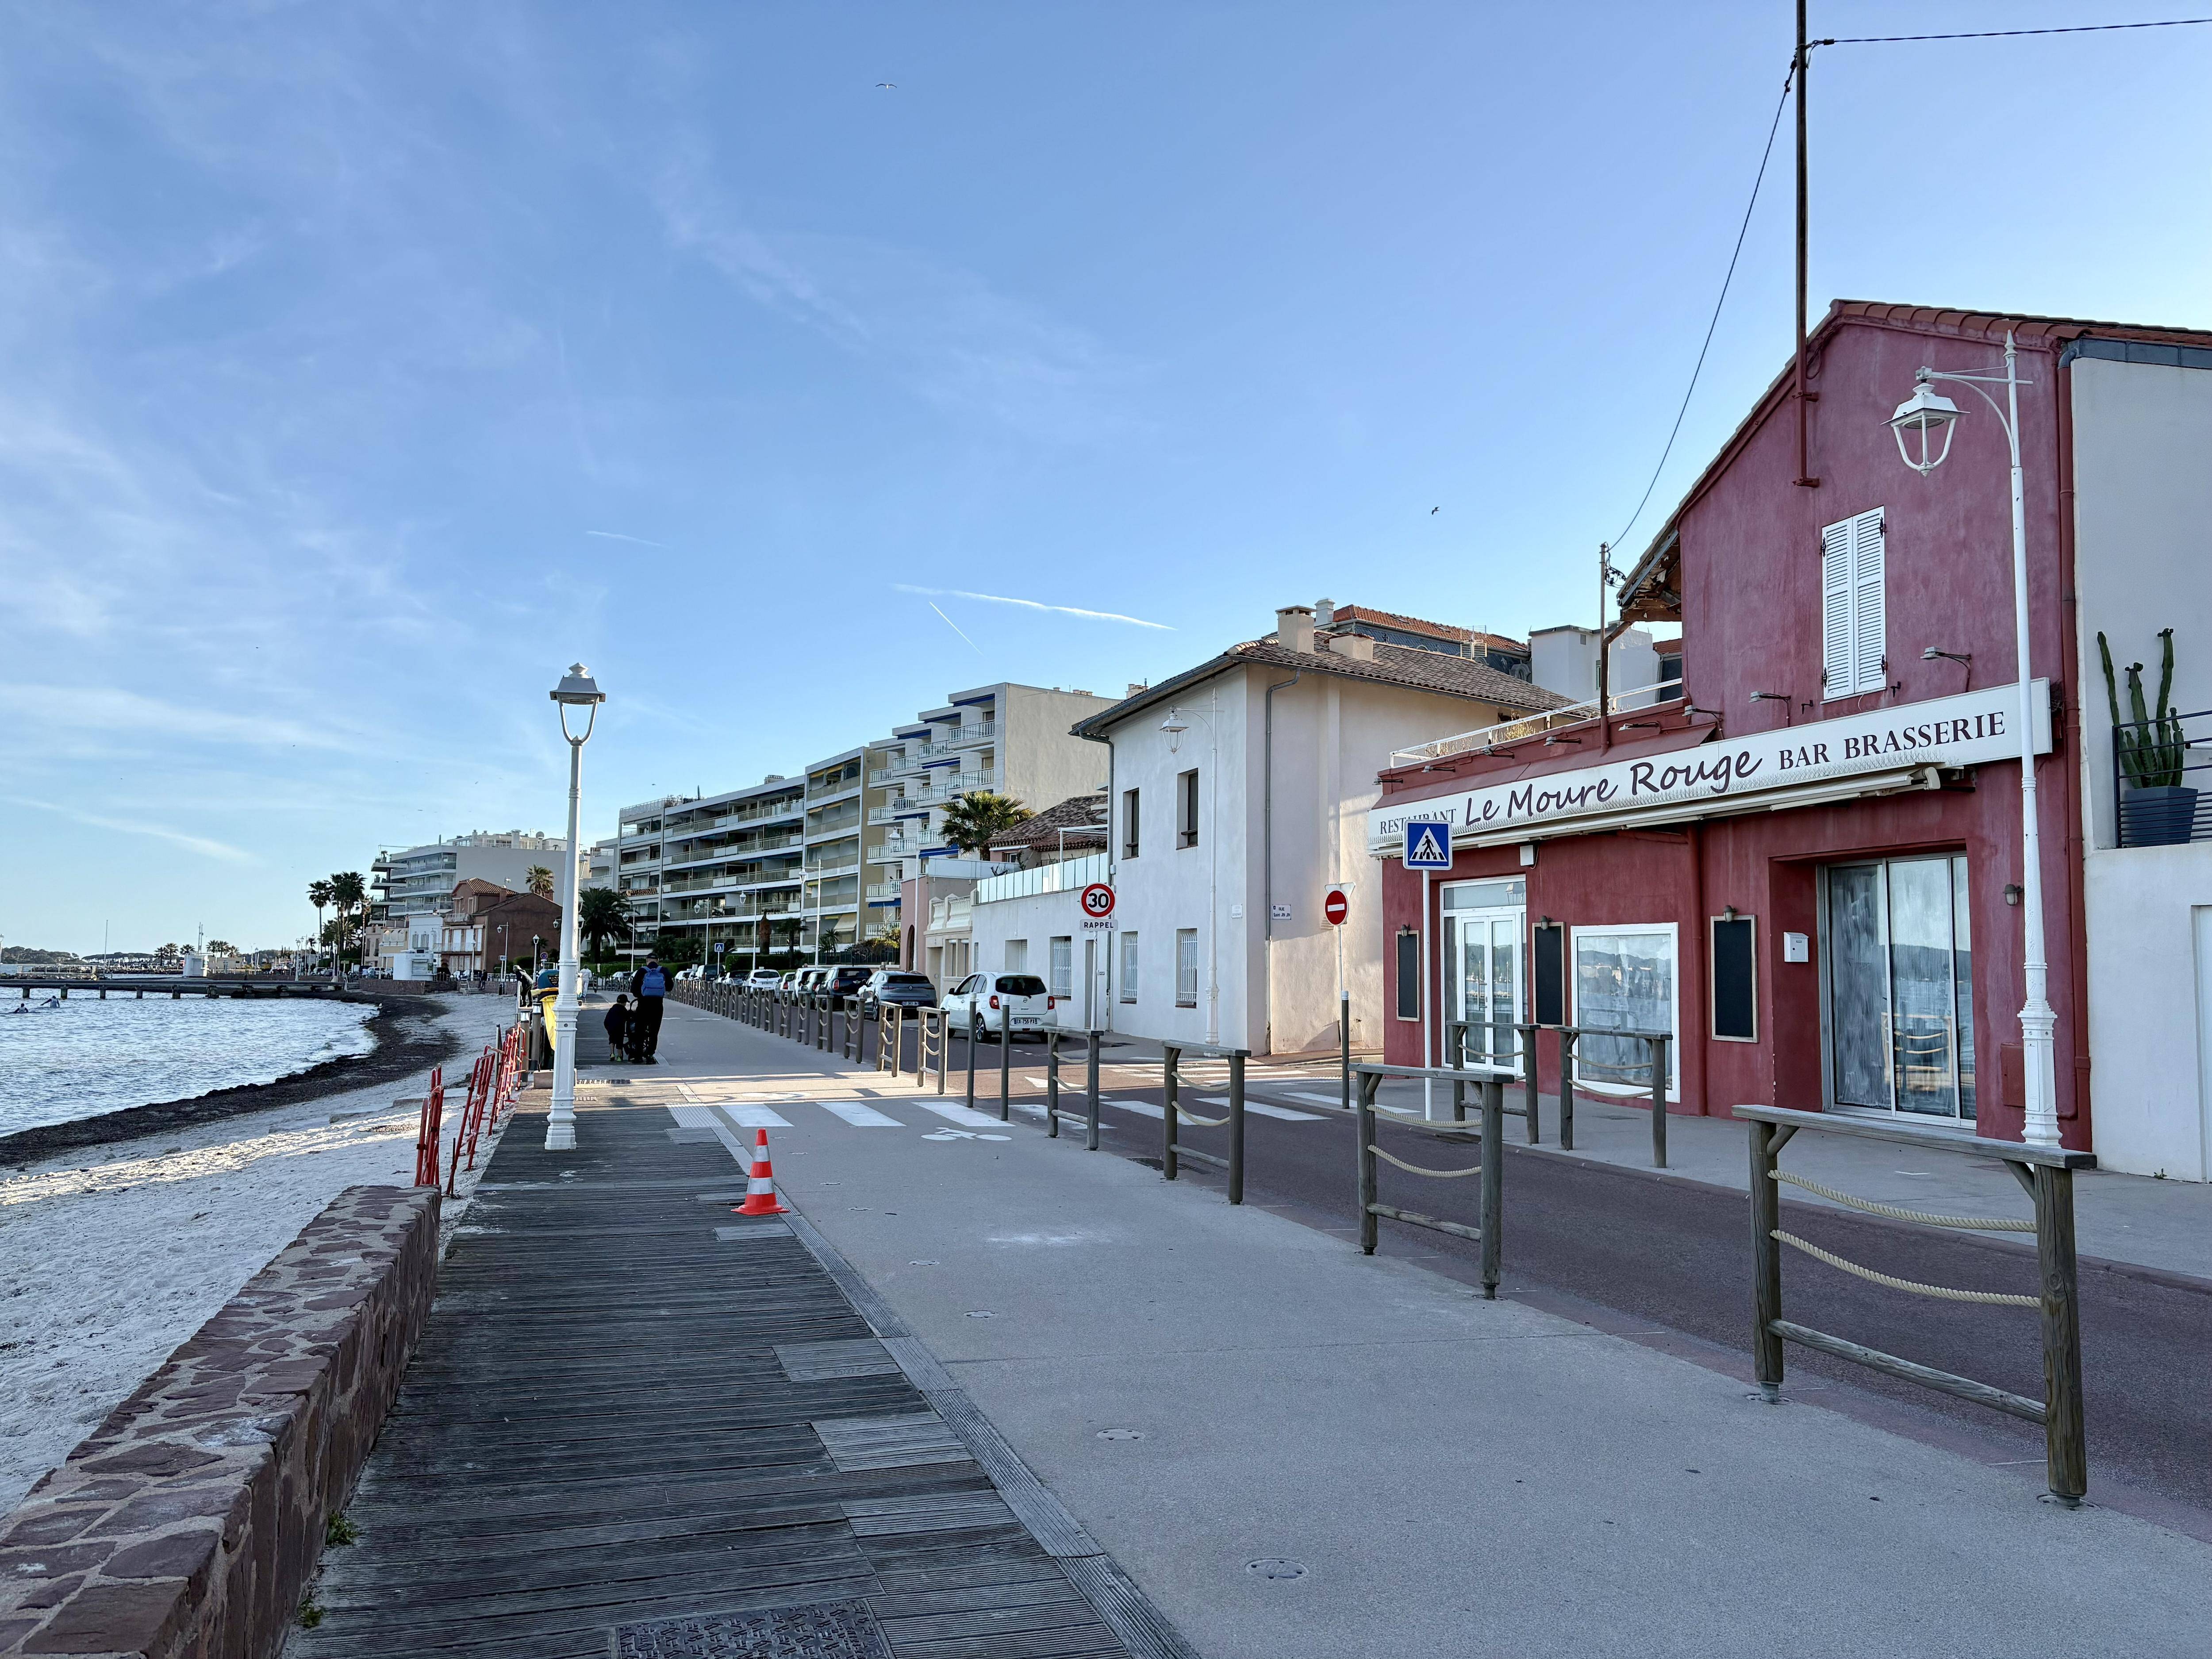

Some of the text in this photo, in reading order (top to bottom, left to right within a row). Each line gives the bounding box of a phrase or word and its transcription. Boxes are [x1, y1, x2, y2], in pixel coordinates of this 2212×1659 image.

[1380, 711, 2005, 834] RESTANT Le Moure Rouge BAR BRASSERIE
[1088, 893, 1109, 908] 30
